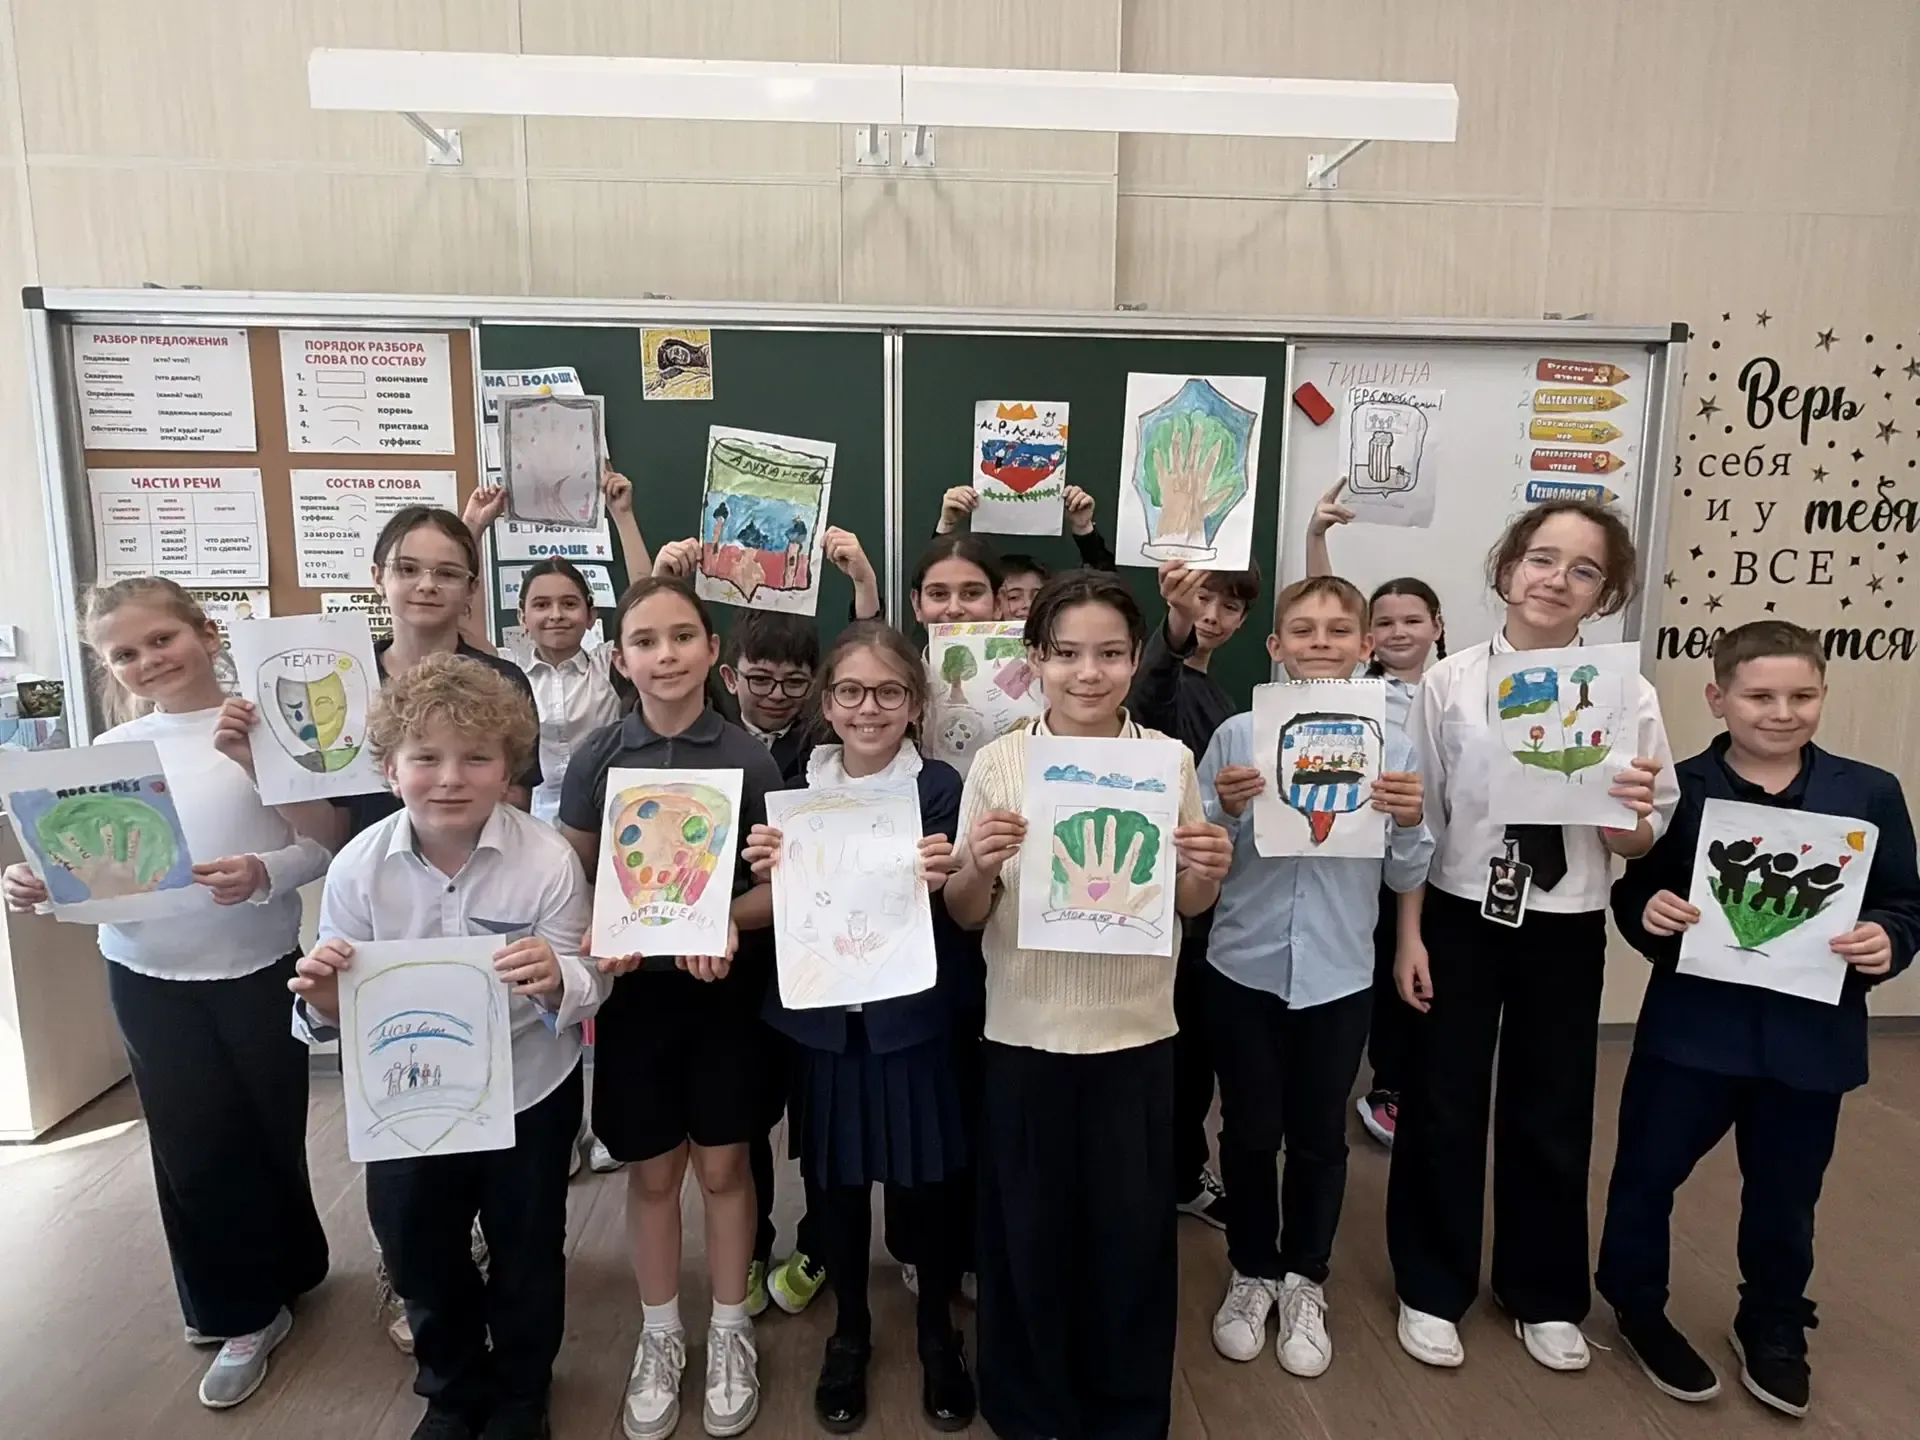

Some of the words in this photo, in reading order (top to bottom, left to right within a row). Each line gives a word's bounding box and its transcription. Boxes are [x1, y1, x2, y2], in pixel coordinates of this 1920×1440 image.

[93, 334, 138, 345] РАЗБОР
[140, 335, 229, 347] ПРЕДЛОЖЕНИЯ
[305, 340, 366, 353] ПОРЯДОК
[368, 342, 424, 353] РАЗБОРА
[305, 354, 347, 365] СЛОВА
[350, 356, 369, 365] ПО
[371, 356, 427, 367] СОСТАВУ
[297, 373, 305, 381] 1.
[1327, 361, 1432, 387] ТИШИНА
[375, 375, 429, 384] окончание
[484, 375, 506, 387] НА
[297, 389, 307, 397] 2.
[376, 391, 411, 399] основа
[1517, 390, 1530, 409] 2
[1737, 356, 1866, 446] Верь
[299, 404, 308, 413] 3.
[377, 407, 413, 416] корень
[300, 420, 309, 428] 4.
[378, 423, 429, 432] приставка
[1518, 422, 1525, 440] 3
[301, 436, 311, 444] 5.
[379, 437, 422, 447] суффикс
[1514, 454, 1523, 468] 4
[1698, 443, 1792, 478] себя
[131, 477, 180, 489] ЧАСТИ
[183, 477, 221, 489] РЕЧИ
[326, 478, 375, 489] СОСТАВ
[378, 478, 422, 490] СЛОВА
[300, 504, 340, 512] приставка
[1706, 498, 1731, 522] и
[1752, 499, 1777, 534] у
[1804, 475, 1920, 535] тебя
[301, 514, 334, 522] суффикс
[509, 523, 519, 533] В
[303, 530, 361, 539] заморозки
[219, 537, 250, 545] делать?
[119, 545, 137, 553] что?
[219, 545, 252, 553] сделать?
[528, 544, 589, 555] БОЛЬШЕ
[210, 568, 247, 576] действие
[1730, 549, 1834, 586] ВСЕ
[320, 572, 349, 580] столе
[280, 653, 336, 668] ТЕАТР
